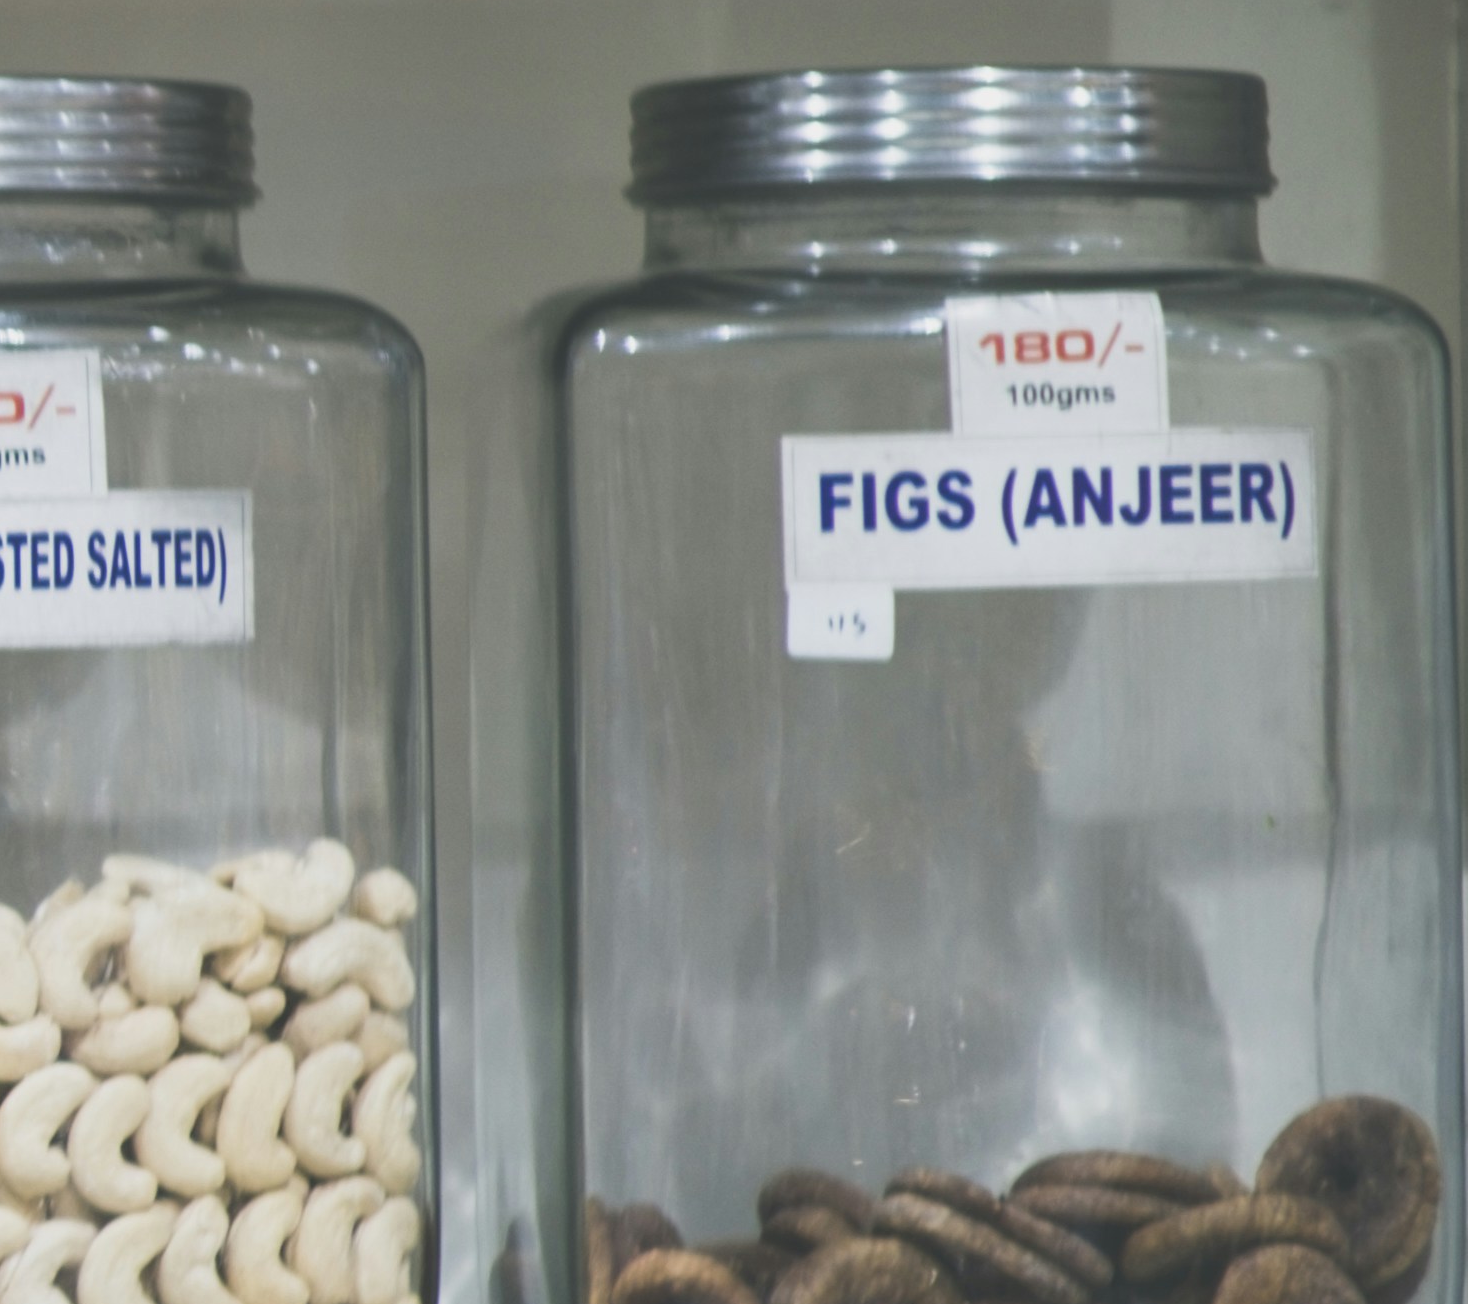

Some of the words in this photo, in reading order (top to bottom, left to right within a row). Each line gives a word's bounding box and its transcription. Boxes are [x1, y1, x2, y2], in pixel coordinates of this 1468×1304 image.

[978, 323, 1148, 368] 180/-
[1007, 382, 1116, 411] 100gms
[819, 469, 976, 534] FIGS
[1001, 460, 1296, 546] (ANJEER)
[87, 527, 227, 605] SALTED)
[828, 612, 866, 636] 115
